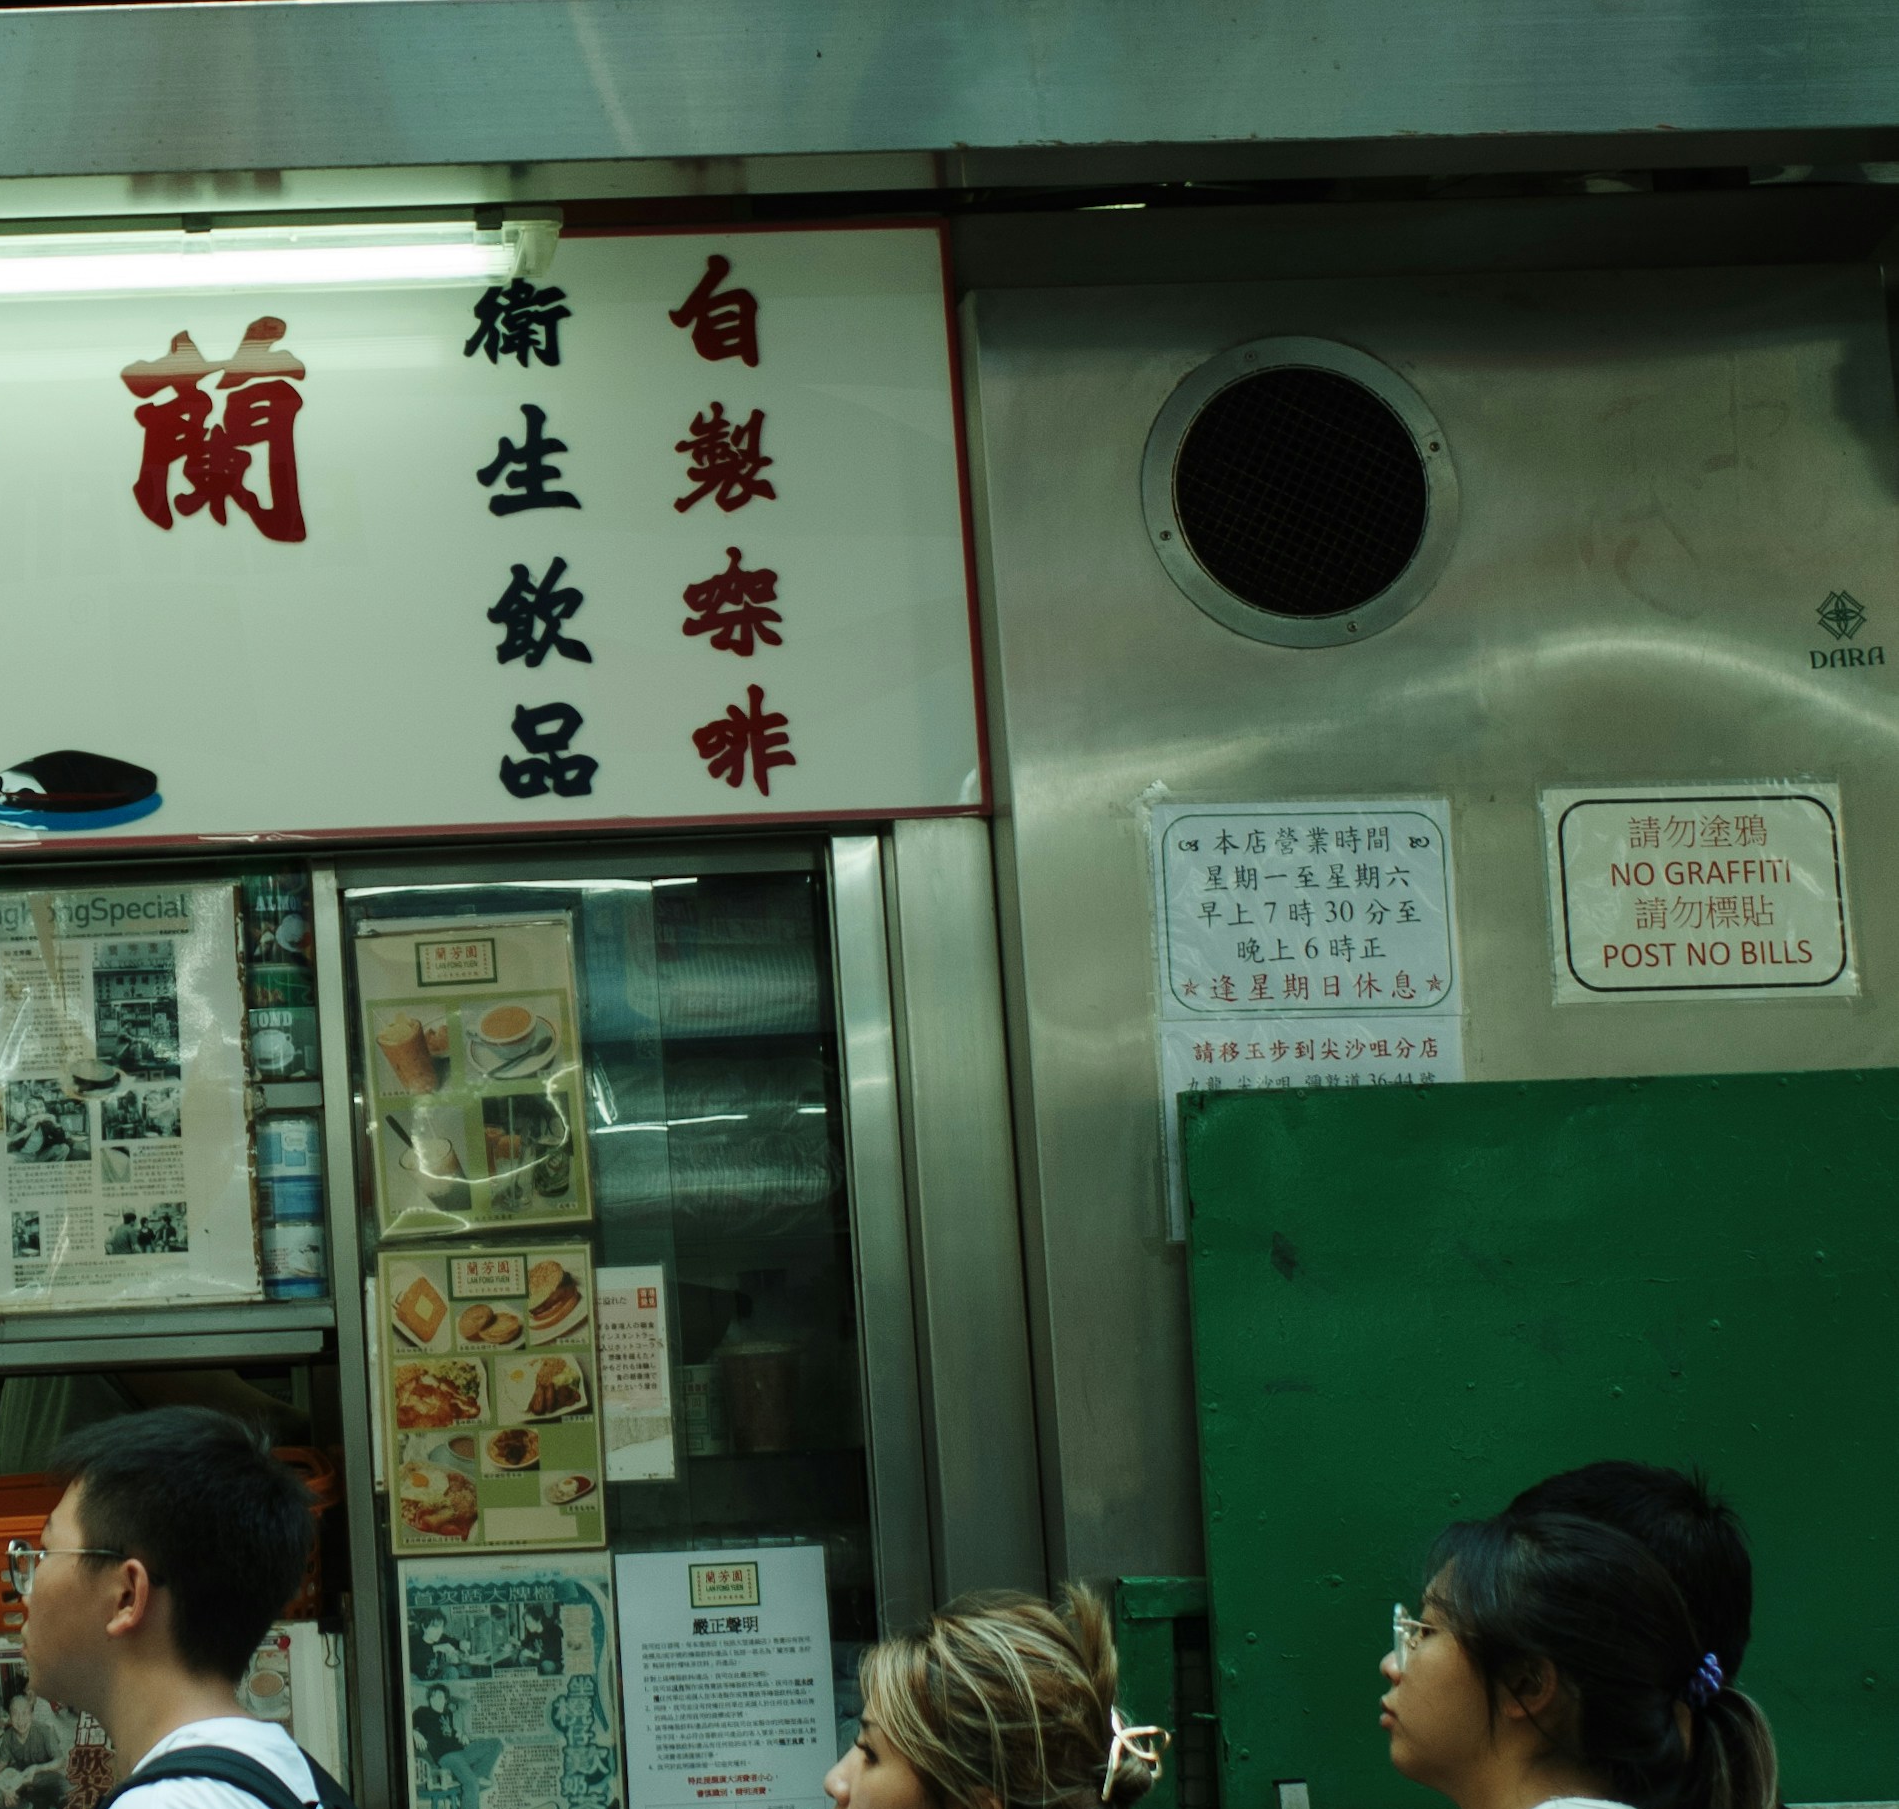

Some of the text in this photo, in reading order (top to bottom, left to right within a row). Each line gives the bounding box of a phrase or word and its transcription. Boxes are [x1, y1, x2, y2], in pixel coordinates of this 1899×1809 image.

[464, 281, 598, 799] 衛生飲品
[1810, 645, 1885, 671] DARA
[1213, 826, 1391, 855] 本店營業時間
[1628, 815, 1769, 849] 請勿塗鴉
[1205, 864, 1411, 891] 星期一至星期六
[1611, 859, 1792, 887] NO GRAFFITI
[1636, 896, 1775, 931] 請勿標貼
[1603, 940, 1813, 969] POST NO BILLS
[1209, 972, 1418, 1004] 逢星期日休息
[1192, 1038, 1439, 1064] 請移玉步到尖沙咀分店
[705, 1569, 744, 1584] 蘭芳園
[692, 1616, 760, 1635] 嚴正聲明
